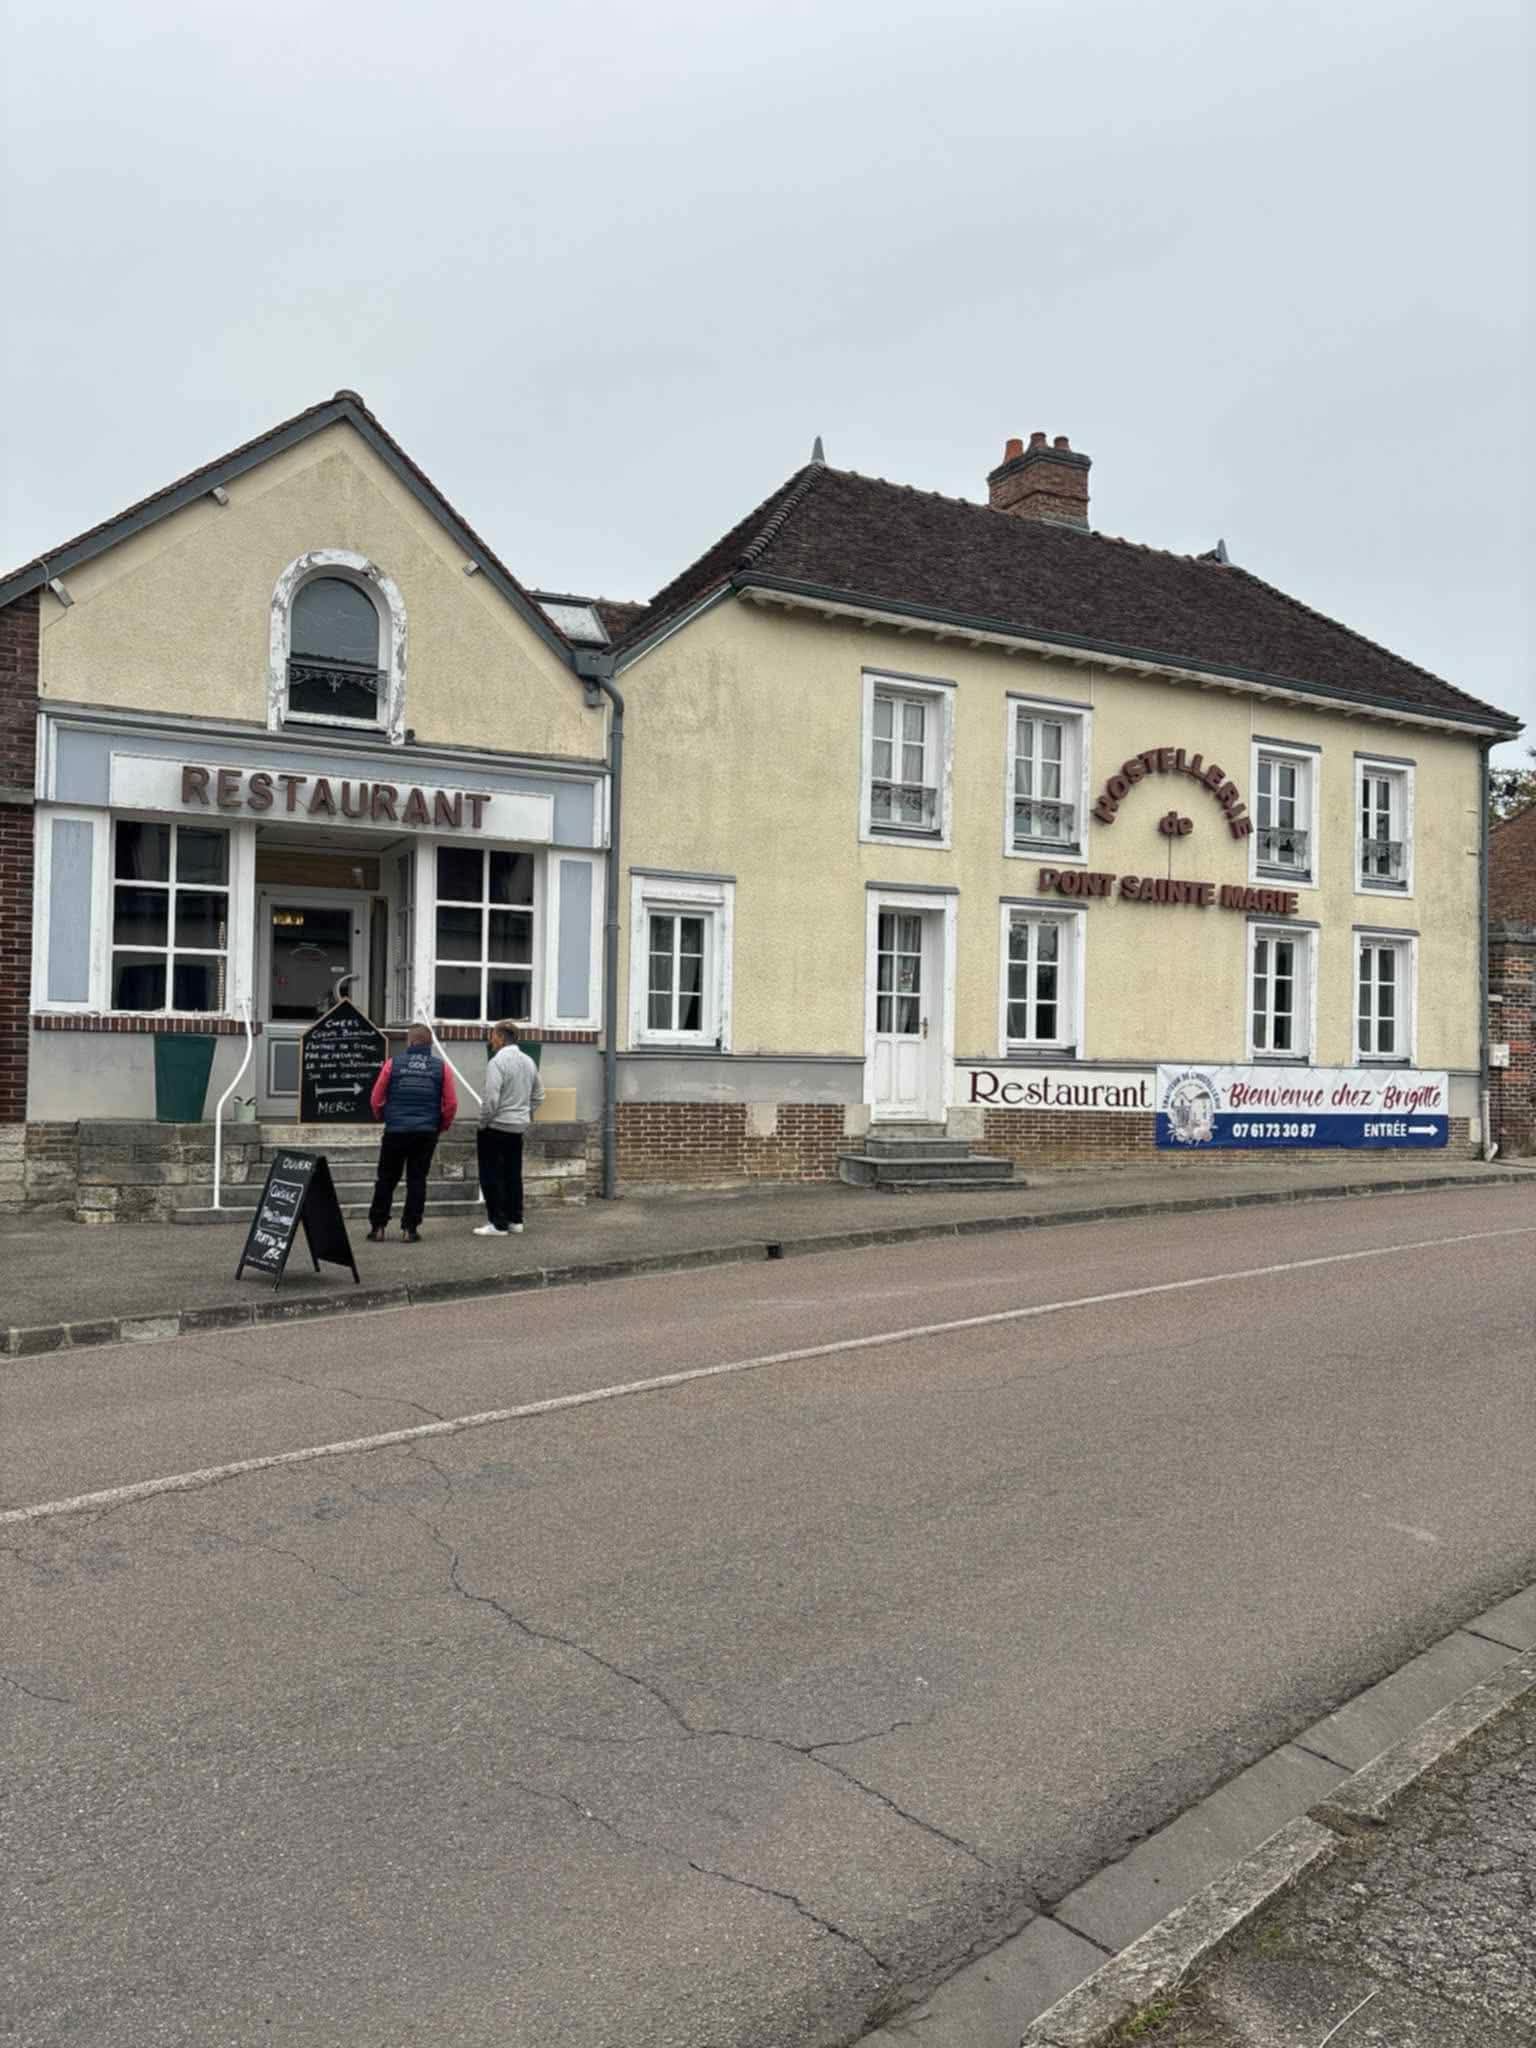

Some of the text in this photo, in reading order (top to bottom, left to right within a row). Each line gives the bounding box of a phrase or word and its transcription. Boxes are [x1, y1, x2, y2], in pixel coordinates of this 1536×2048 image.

[180, 765, 491, 829] RESTAURANT
[1093, 747, 1254, 841] HOSTELLERIE
[1158, 809, 1194, 837] de
[1038, 867, 1299, 915] PONT SAINTE MARIE
[968, 1070, 1152, 1108] Restaurant
[1223, 1082, 1441, 1114] Bienvenue chez Brigitte
[1232, 1123, 1317, 1138] 07 61 73 30 87
[1363, 1120, 1408, 1138] ENTRÉE
